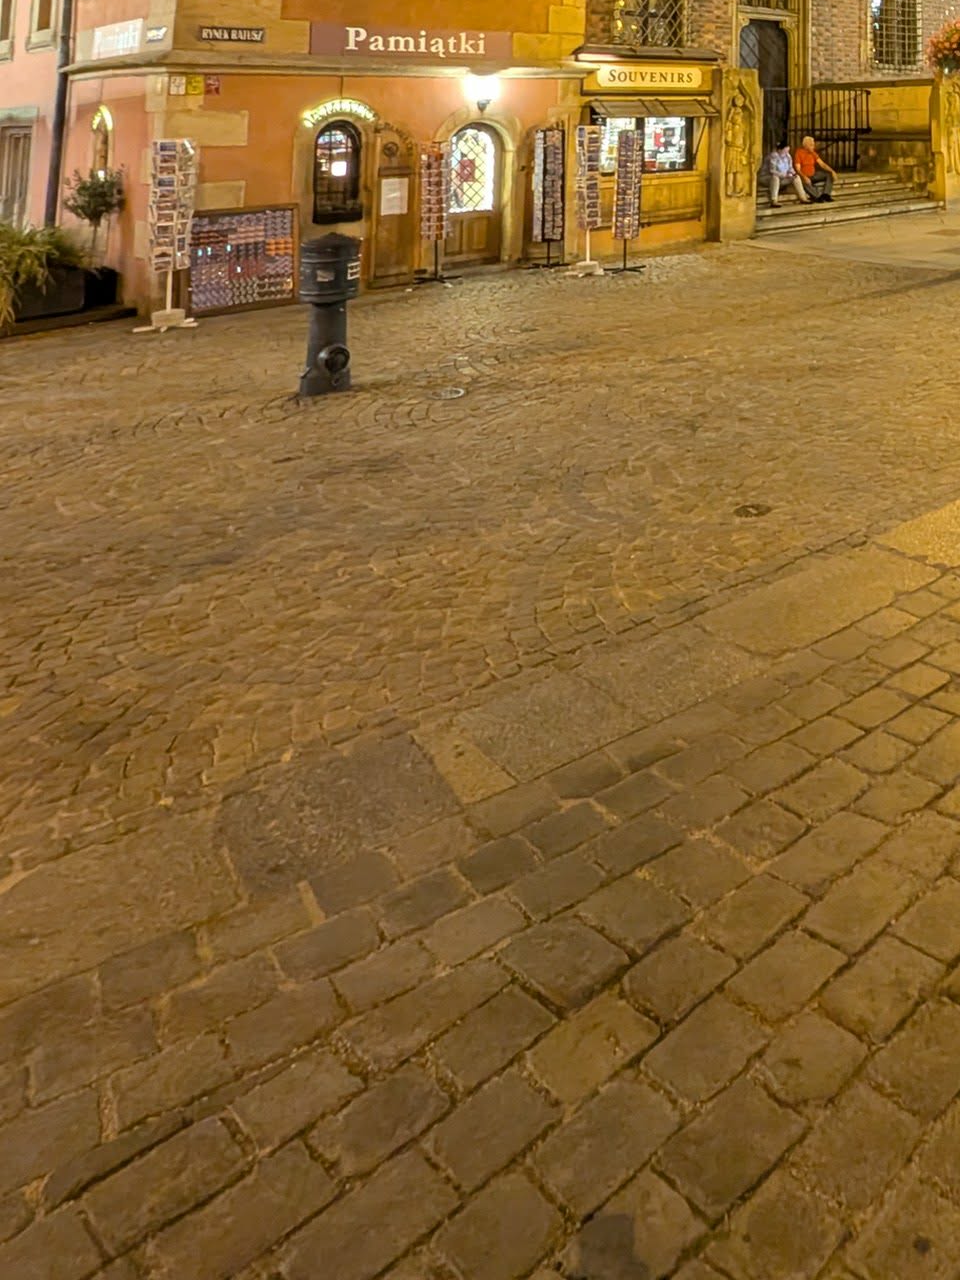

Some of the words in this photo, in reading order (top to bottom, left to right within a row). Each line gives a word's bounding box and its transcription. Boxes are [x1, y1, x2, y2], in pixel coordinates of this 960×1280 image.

[201, 28, 230, 40] RYNEK
[345, 26, 486, 58] Pamiątki
[608, 69, 693, 83] SOUVENIRS
